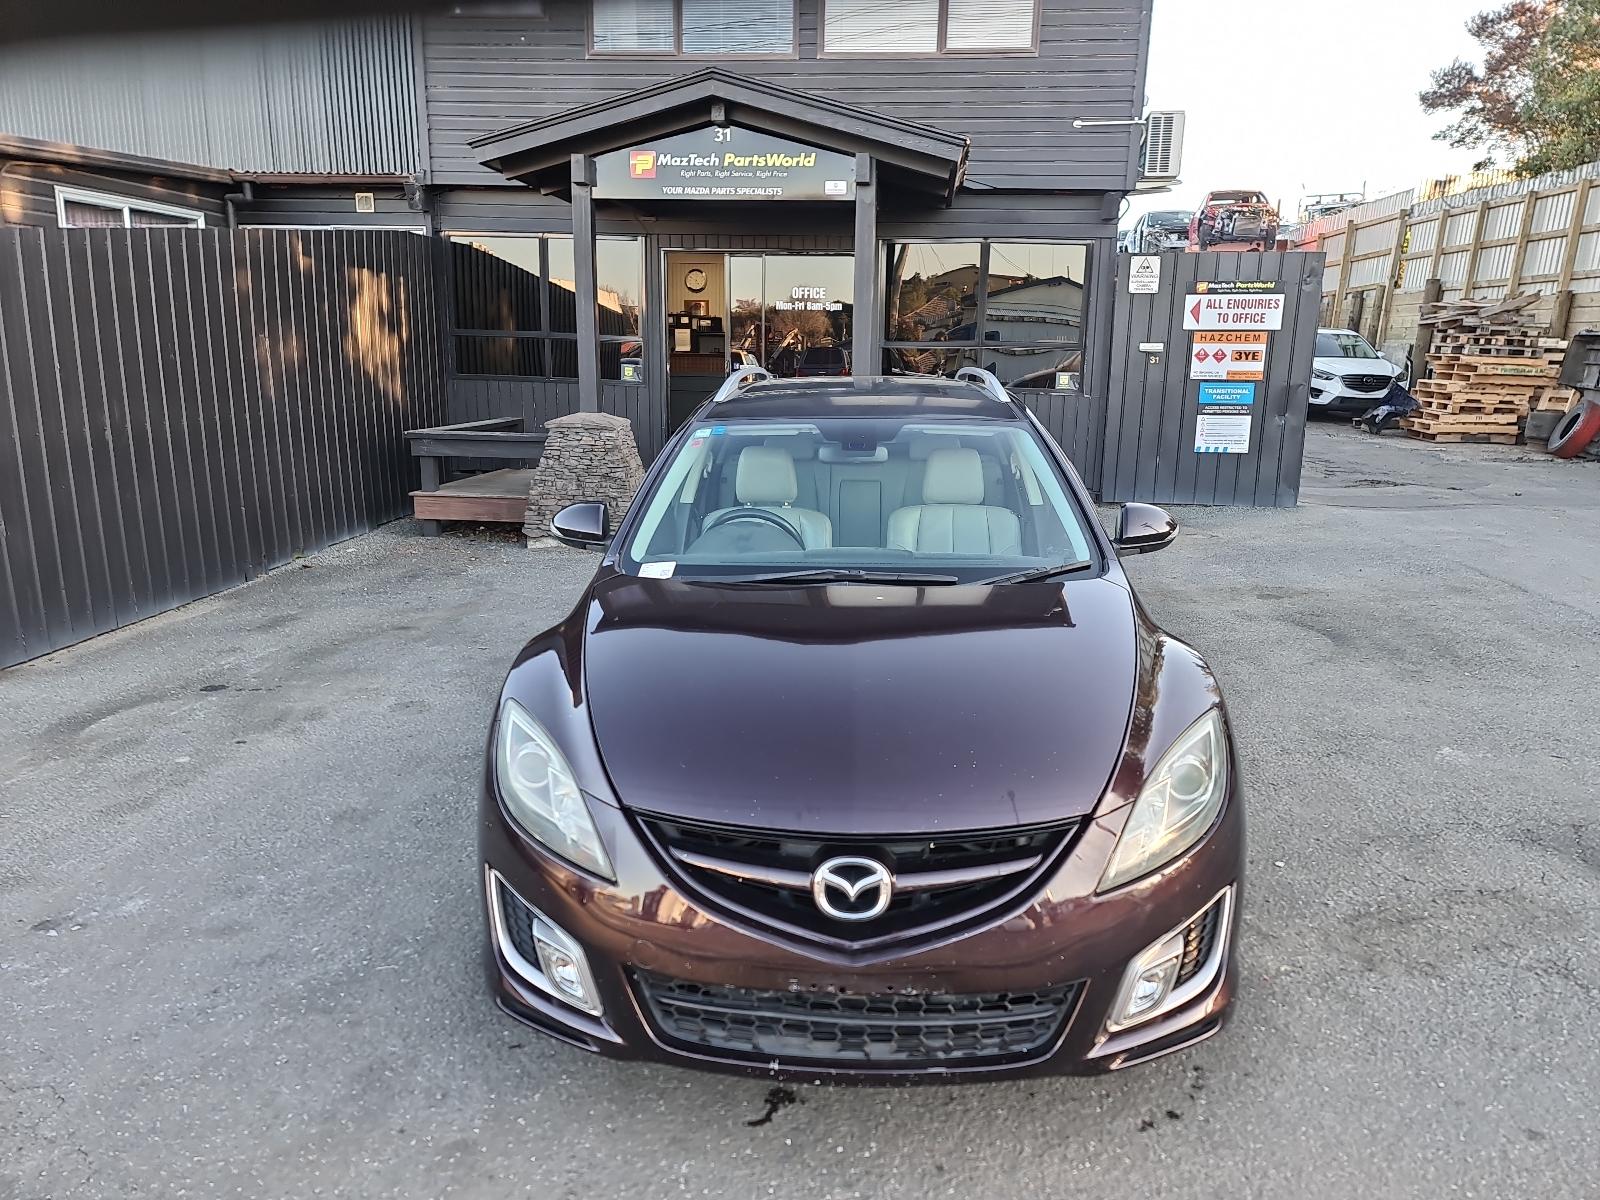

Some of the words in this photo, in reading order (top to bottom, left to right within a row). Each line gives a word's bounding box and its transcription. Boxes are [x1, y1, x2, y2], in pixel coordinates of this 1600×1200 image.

[714, 127, 731, 142] 31
[657, 152, 720, 167] MazTech
[723, 152, 817, 167] PartsWorld
[680, 169, 696, 179] Right
[714, 169, 730, 179] Right
[756, 170, 772, 179] Right
[662, 186, 684, 195] YOUR
[684, 186, 710, 195] MAZDA
[711, 187, 735, 195] PARTS
[736, 187, 783, 196] SPECIALISTS
[1207, 281, 1235, 289] MazTech
[1235, 281, 1276, 289] PartsWorld
[792, 286, 826, 299] OFFICE
[775, 300, 805, 311] Mon-Fri
[806, 301, 843, 312] 8am-5pm
[1206, 298, 1224, 310] ALL
[1226, 298, 1281, 311] ENQUIRIES
[1217, 312, 1230, 324] TO
[1232, 312, 1267, 324] OFFICE
[1199, 333, 1261, 342] HAZCHEM
[1150, 356, 1160, 364] 31
[1234, 351, 1260, 361] 3YE
